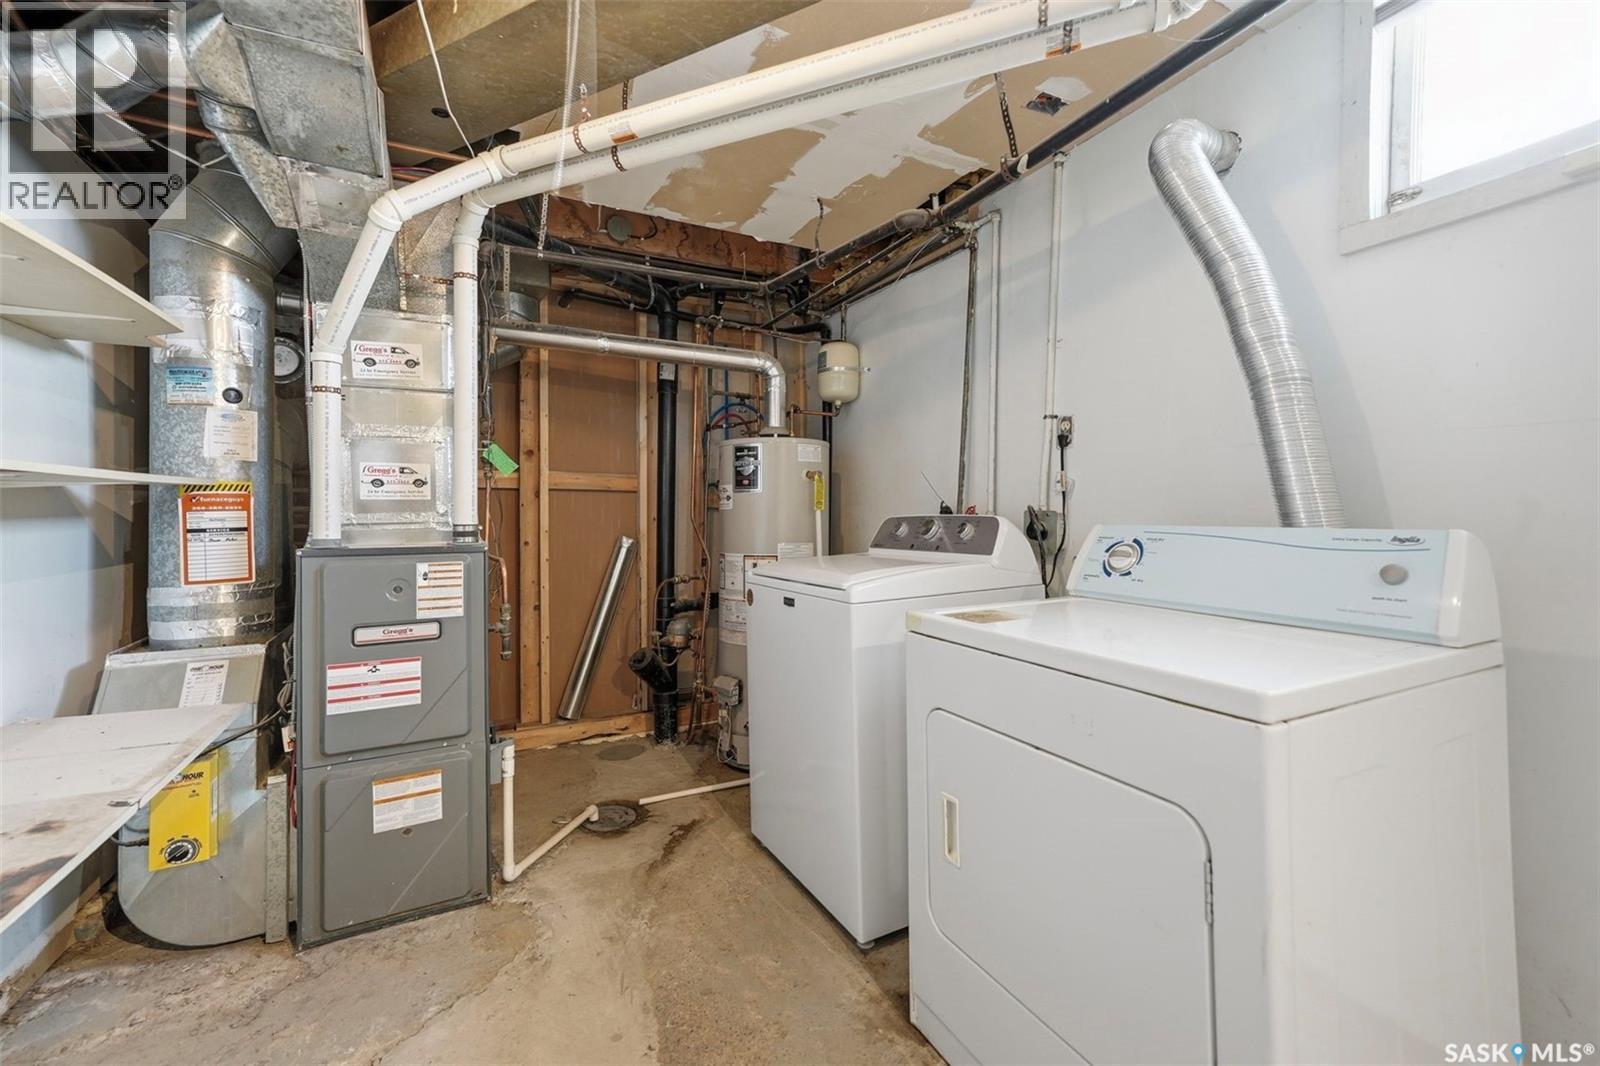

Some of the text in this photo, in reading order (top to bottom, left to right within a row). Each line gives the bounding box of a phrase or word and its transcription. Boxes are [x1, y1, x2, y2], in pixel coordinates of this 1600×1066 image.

[367, 465, 396, 475] Gregg's
[382, 626, 414, 635] Gregg's
[181, 771, 205, 781] HOUR
